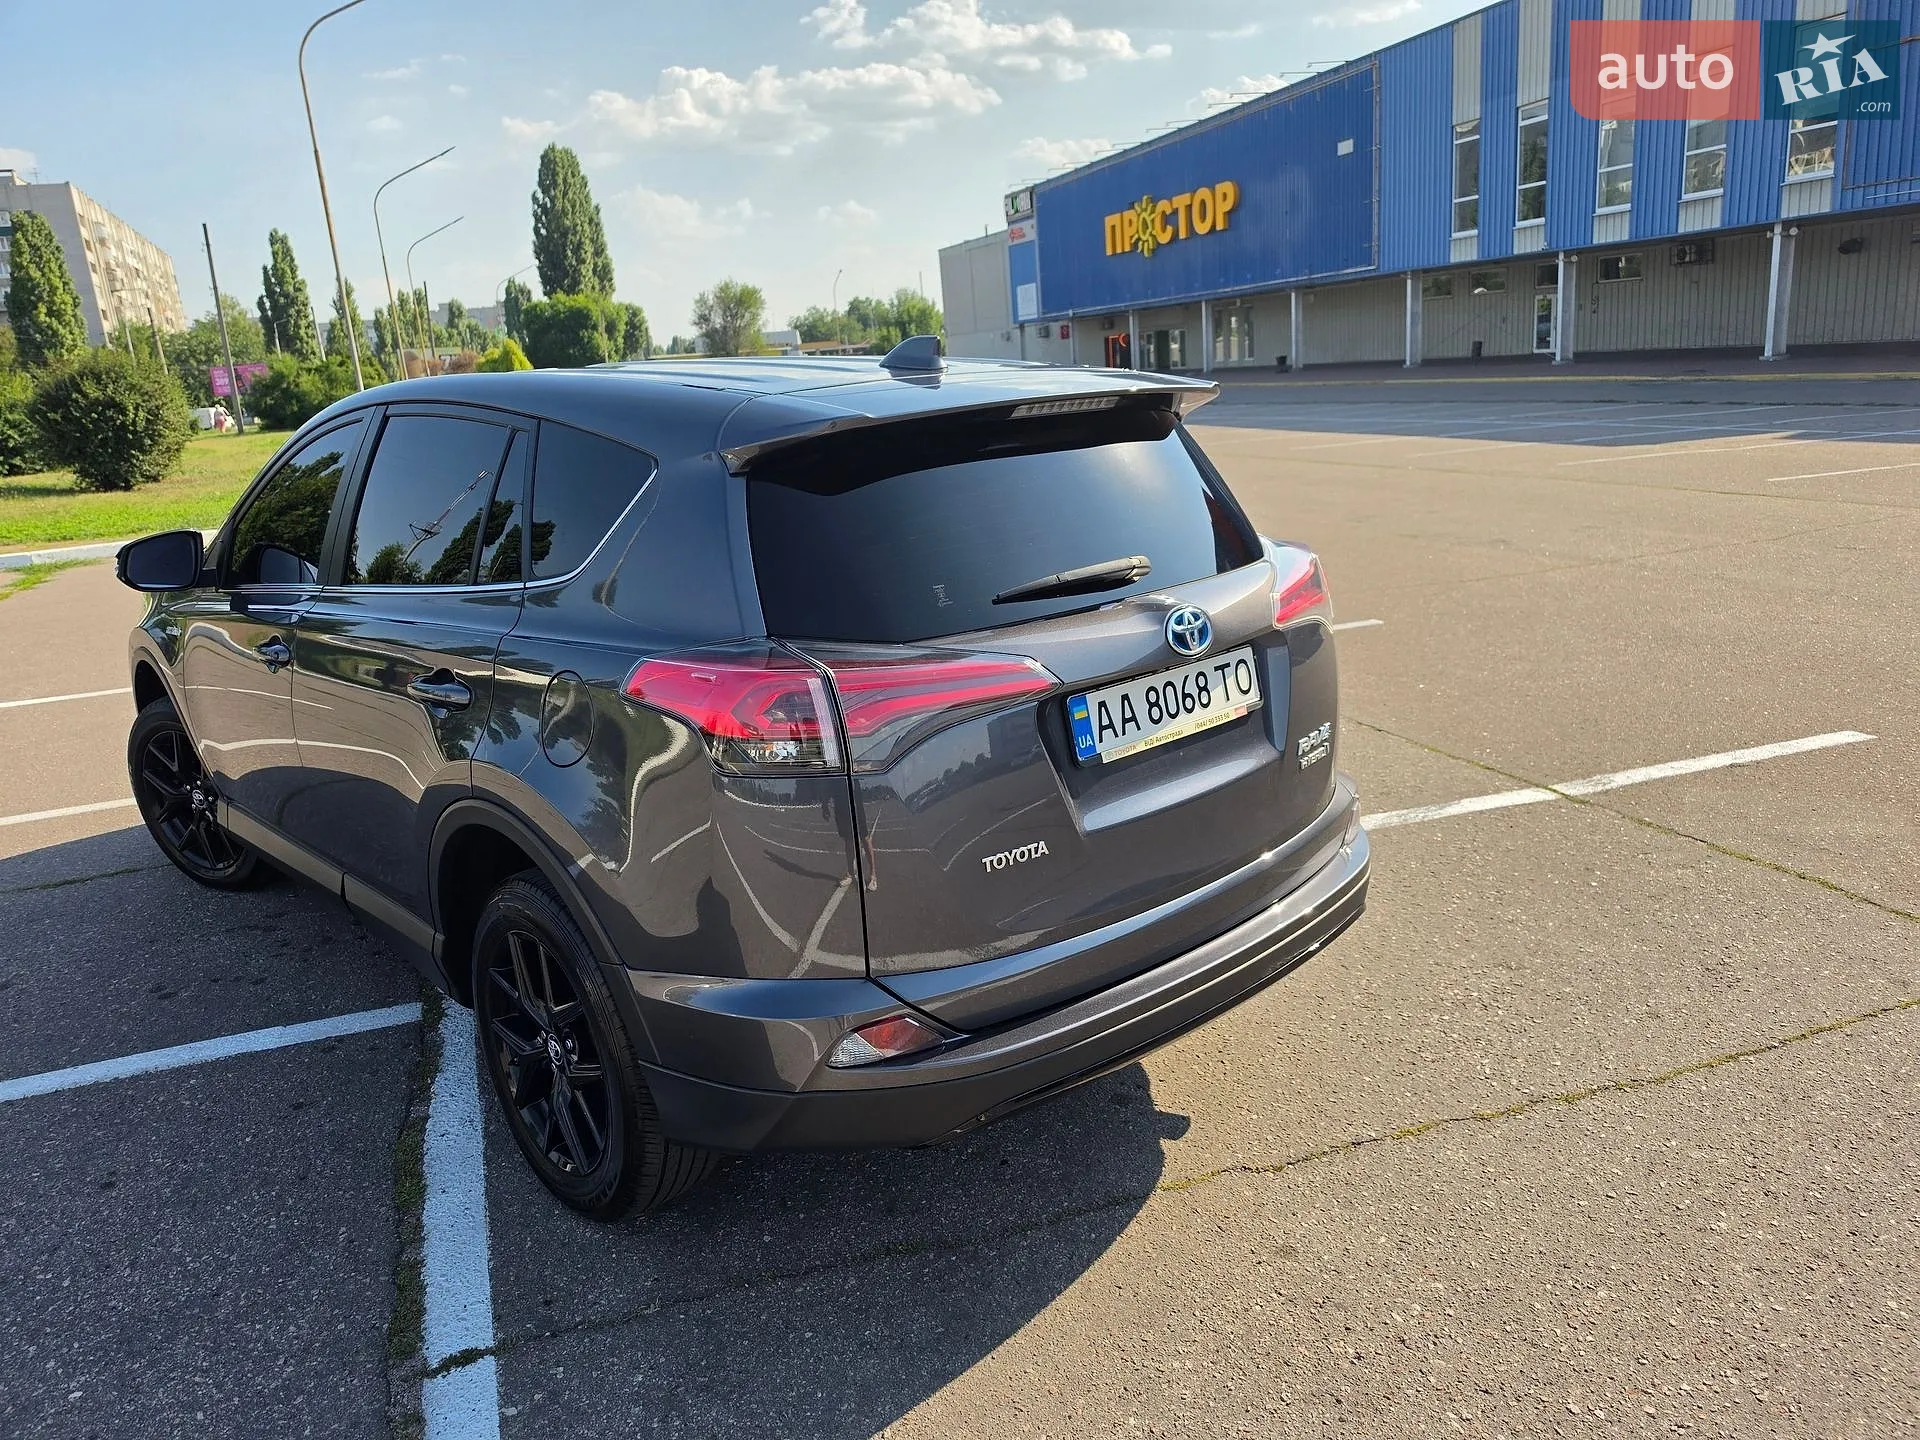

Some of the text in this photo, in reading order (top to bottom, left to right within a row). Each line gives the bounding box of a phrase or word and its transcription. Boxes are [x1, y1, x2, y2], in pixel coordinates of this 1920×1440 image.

[1104, 180, 1240, 257] ПРОСТОР
[1097, 658, 1252, 744] AA 8068 TO
[1078, 736, 1095, 749] UA
[981, 840, 1050, 873] TOYOTA
